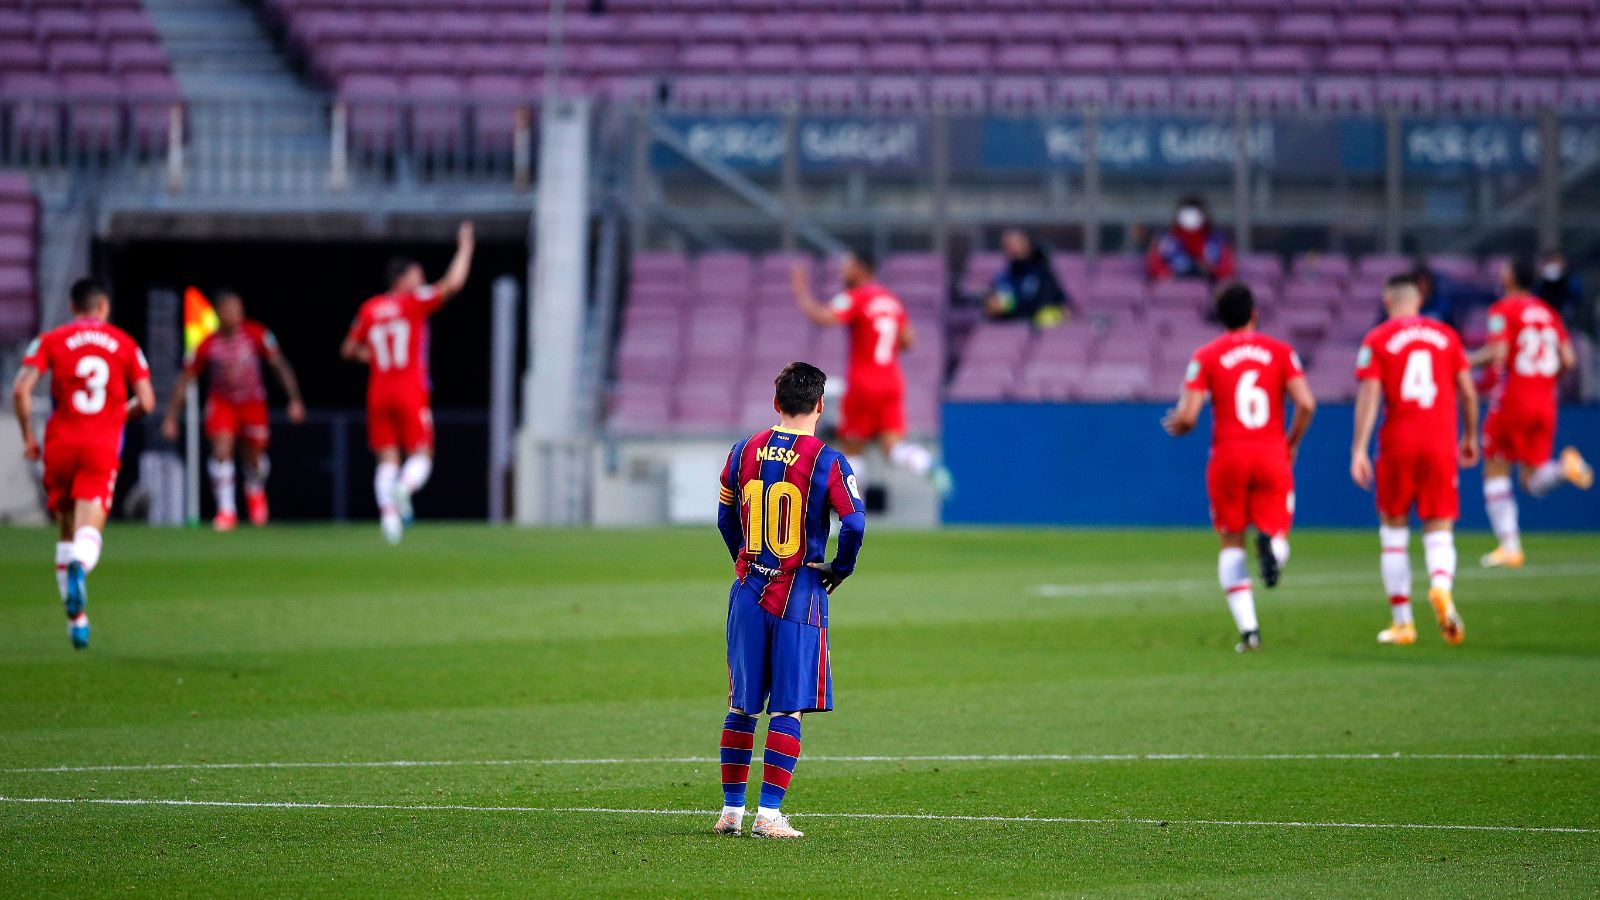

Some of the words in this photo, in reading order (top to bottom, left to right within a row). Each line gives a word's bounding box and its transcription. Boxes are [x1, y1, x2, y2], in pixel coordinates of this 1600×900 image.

[369, 318, 410, 372] 17
[874, 316, 898, 365] 7
[1515, 325, 1561, 377] 23
[72, 355, 109, 414] 3
[1234, 369, 1270, 429] 6
[1400, 348, 1438, 409] 4
[756, 446, 800, 466] MESSI
[742, 479, 803, 558] 10
